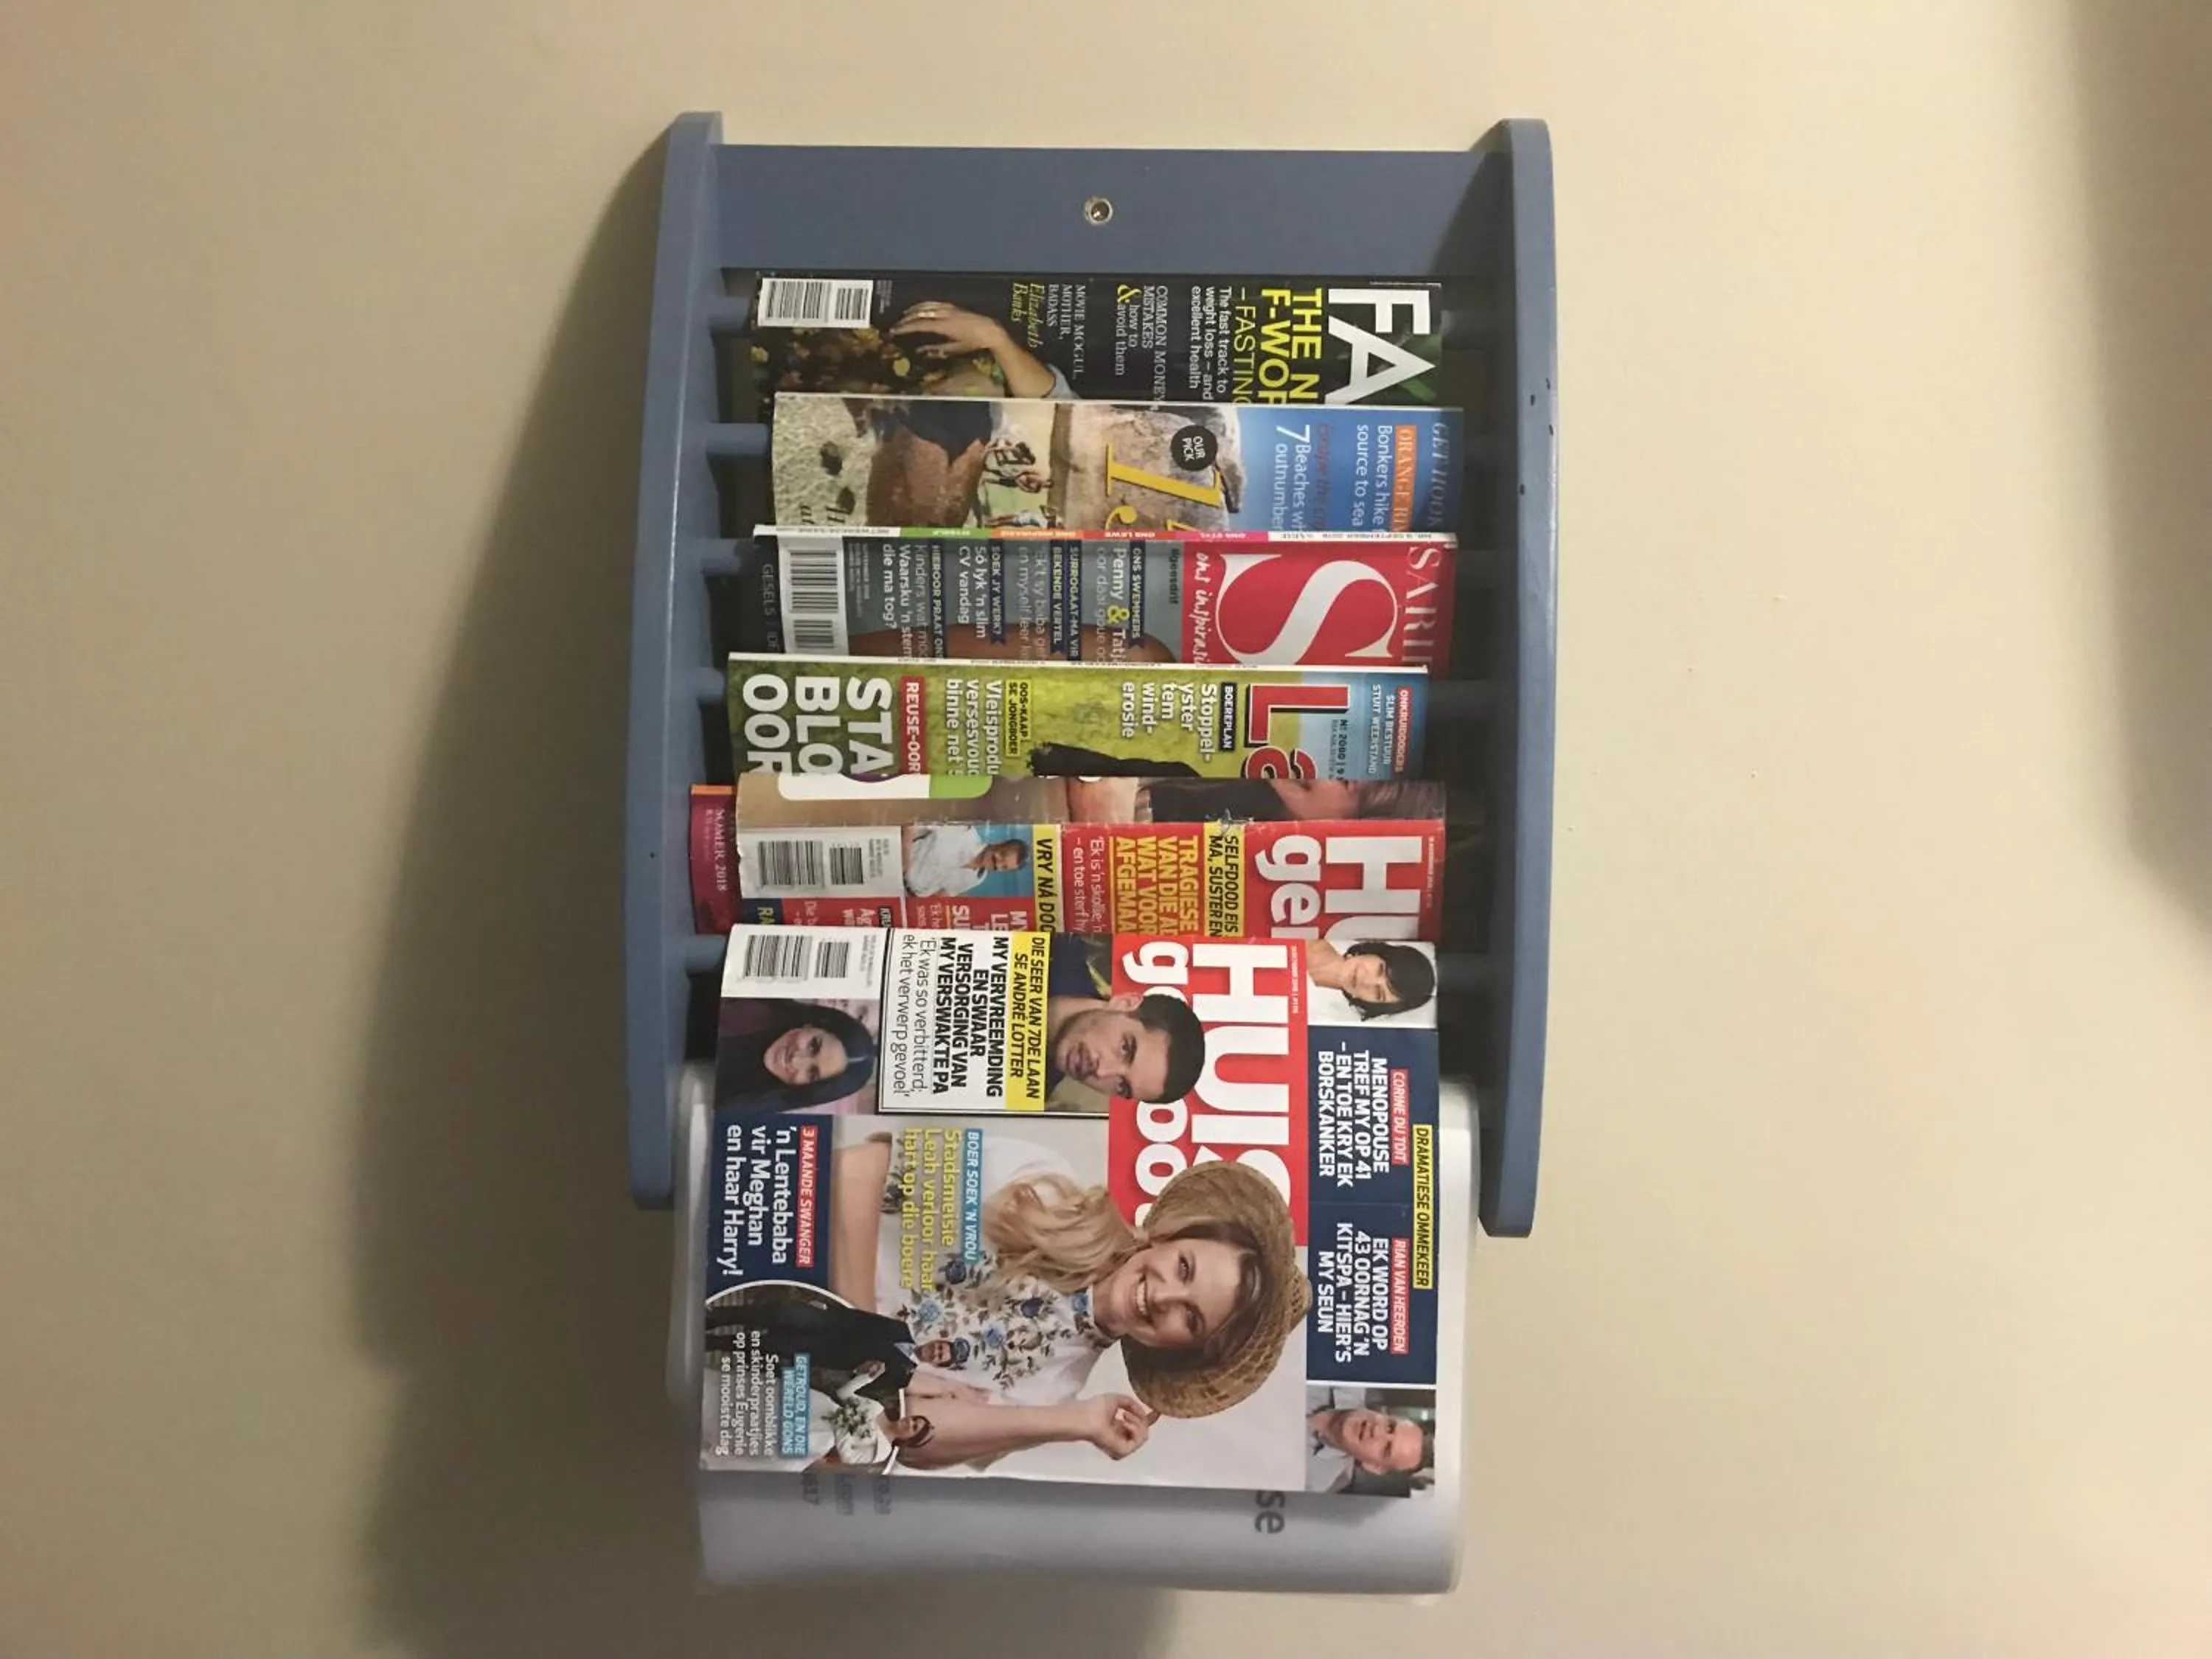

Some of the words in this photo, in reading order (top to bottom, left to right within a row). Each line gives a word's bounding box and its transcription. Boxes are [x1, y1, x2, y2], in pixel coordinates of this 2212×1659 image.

[1010, 282, 1028, 323] Banks
[1046, 283, 1058, 327] BADASS
[1074, 284, 1085, 321] MOVIE
[1116, 285, 1142, 303] &
[1203, 286, 1217, 324] weight
[1219, 286, 1231, 307] The
[1026, 282, 1045, 349] Elizabeth
[1115, 302, 1127, 337] avoid
[1128, 304, 1140, 330] how
[1141, 285, 1155, 349] MISTAKES
[1155, 285, 1167, 346] COMMON
[1190, 286, 1203, 341] excellent
[1218, 310, 1231, 334] fast
[1291, 288, 1323, 359] THE
[1115, 341, 1127, 375] them
[1128, 334, 1139, 347] to
[1203, 328, 1217, 358] loss
[1217, 339, 1230, 375] track
[1189, 345, 1202, 389] health
[1202, 374, 1214, 400] and
[1217, 380, 1229, 393] to
[1181, 437, 1194, 461] PICK
[1192, 436, 1206, 460] OUR
[1276, 424, 1310, 442] 7
[1293, 445, 1311, 507] Beaches
[1354, 424, 1370, 476] source
[1375, 425, 1393, 488] Bonkers
[1395, 428, 1414, 502] ORANGE
[1354, 480, 1369, 497] to
[1350, 501, 1365, 526] sea
[1372, 493, 1389, 525] hike
[883, 543, 894, 566] die
[959, 546, 971, 567] CV
[1052, 546, 1062, 599] BEKENDE
[1132, 548, 1143, 571] ONS
[1193, 553, 1211, 583] ons
[883, 570, 893, 594] ma
[898, 544, 911, 607] Waarsku
[971, 568, 987, 590] lyk
[1110, 548, 1127, 600] Penny
[883, 597, 897, 629] tog?
[958, 571, 971, 625] vandag
[1107, 605, 1130, 625] &
[1131, 575, 1141, 639] SWEMMERS
[932, 599, 942, 635] PRAAT
[975, 611, 987, 639] slim
[1052, 605, 1062, 644] VERTEL
[945, 678, 964, 728] binne
[1008, 682, 1017, 696] SE
[1161, 682, 1176, 719] tem
[1180, 682, 1196, 731] yster
[1371, 684, 1382, 714] STUIT
[1385, 695, 1394, 718] SLIM
[794, 675, 844, 775] BLO
[846, 676, 894, 775] STA
[1019, 682, 1029, 737] OOS-KAAP
[1121, 681, 1138, 738] erosie
[1141, 682, 1158, 734] wind-
[1197, 683, 1217, 762] Stoppel-
[1222, 686, 1234, 749] BOEREPLAN
[1008, 699, 1018, 755] JONGBOER
[1382, 720, 1394, 765] BESTUUR
[947, 734, 962, 762] net
[1036, 838, 1054, 873] VRY
[1073, 847, 1085, 864] en
[1090, 836, 1105, 856] 'Ek
[1137, 836, 1158, 882] WAT
[1158, 836, 1178, 879] VAN
[1207, 835, 1223, 863] MA,
[714, 863, 728, 891] 2018
[1073, 866, 1087, 887] toe
[1090, 860, 1104, 871] is
[1179, 835, 1199, 931] TRAGIESE
[1224, 835, 1239, 911] SELFDOOD
[1158, 882, 1178, 914] DIE
[1208, 866, 1223, 919] SUSTER
[1208, 921, 1223, 937] EN
[1225, 914, 1239, 933] EIS
[902, 934, 917, 951] ek
[939, 936, 956, 961] MY
[992, 936, 1009, 961] MY
[1032, 937, 1045, 956] DIE
[900, 952, 915, 975] het
[917, 958, 930, 987] was
[1014, 953, 1028, 969] SE
[1029, 959, 1044, 993] SEER
[915, 990, 928, 1007] so
[952, 943, 973, 1048] VERSORGING
[973, 969, 989, 992] EN
[891, 977, 911, 1040] verwerp
[933, 963, 954, 1068] VERSWAKTE
[970, 995, 988, 1057] SWAAR
[1028, 998, 1043, 1026] VAN
[986, 963, 1007, 1097] VERVREEMDING
[1010, 1023, 1024, 1078] LOTTER
[1336, 1054, 1352, 1079] EN
[932, 1071, 949, 1095] PA
[950, 1051, 967, 1088] VAN
[1026, 1060, 1040, 1099] LAAN
[1353, 1050, 1370, 1096] TREF
[1318, 1051, 1335, 1177] BORSKANKER
[1336, 1082, 1353, 1117] TOE
[1354, 1099, 1371, 1130] MY
[1371, 1057, 1389, 1173] MENOPOUSE
[726, 1124, 742, 1151] en
[751, 1124, 771, 1155] vir
[904, 1127, 922, 1169] hart
[923, 1127, 942, 1174] Leah
[967, 1131, 979, 1166] BOER
[1337, 1121, 1353, 1159] KRY
[1354, 1132, 1371, 1158] OP
[724, 1156, 746, 1205] haar
[801, 1140, 814, 1195] MAANDE
[898, 1172, 916, 1196] op
[1337, 1163, 1354, 1187] EK
[1355, 1160, 1371, 1180] 41
[1416, 1127, 1430, 1208] DRAMATIESE
[742, 1158, 771, 1245] Meghan
[941, 1128, 961, 1246] Stadsmeisie
[966, 1169, 978, 1205] SOEK
[772, 1149, 797, 1264] Lentebaba
[902, 1200, 919, 1230] die
[922, 1179, 939, 1244] verloor
[716, 1208, 744, 1276] Harry!
[799, 1198, 813, 1265] SWANGER
[964, 1225, 977, 1261] VROU
[1354, 1231, 1371, 1255] 43
[1416, 1212, 1430, 1287] OMMEKEER
[900, 1234, 917, 1287] boere
[1318, 1251, 1335, 1281] MY
[1336, 1222, 1353, 1288] KITSPA
[1372, 1238, 1388, 1262] EK
[920, 1250, 937, 1291] haar
[1318, 1284, 1334, 1332] SEUN
[1354, 1258, 1371, 1334] OORNAG
[1372, 1265, 1388, 1321] WORD
[732, 1332, 746, 1349] op
[751, 1330, 762, 1347] en
[1371, 1325, 1388, 1350] OP
[720, 1356, 731, 1372] se
[733, 1351, 748, 1399] prinses
[765, 1354, 779, 1385] Soet
[720, 1374, 733, 1427] mooiste
[763, 1386, 778, 1456] oomblikke
[715, 1430, 733, 1456] dag
